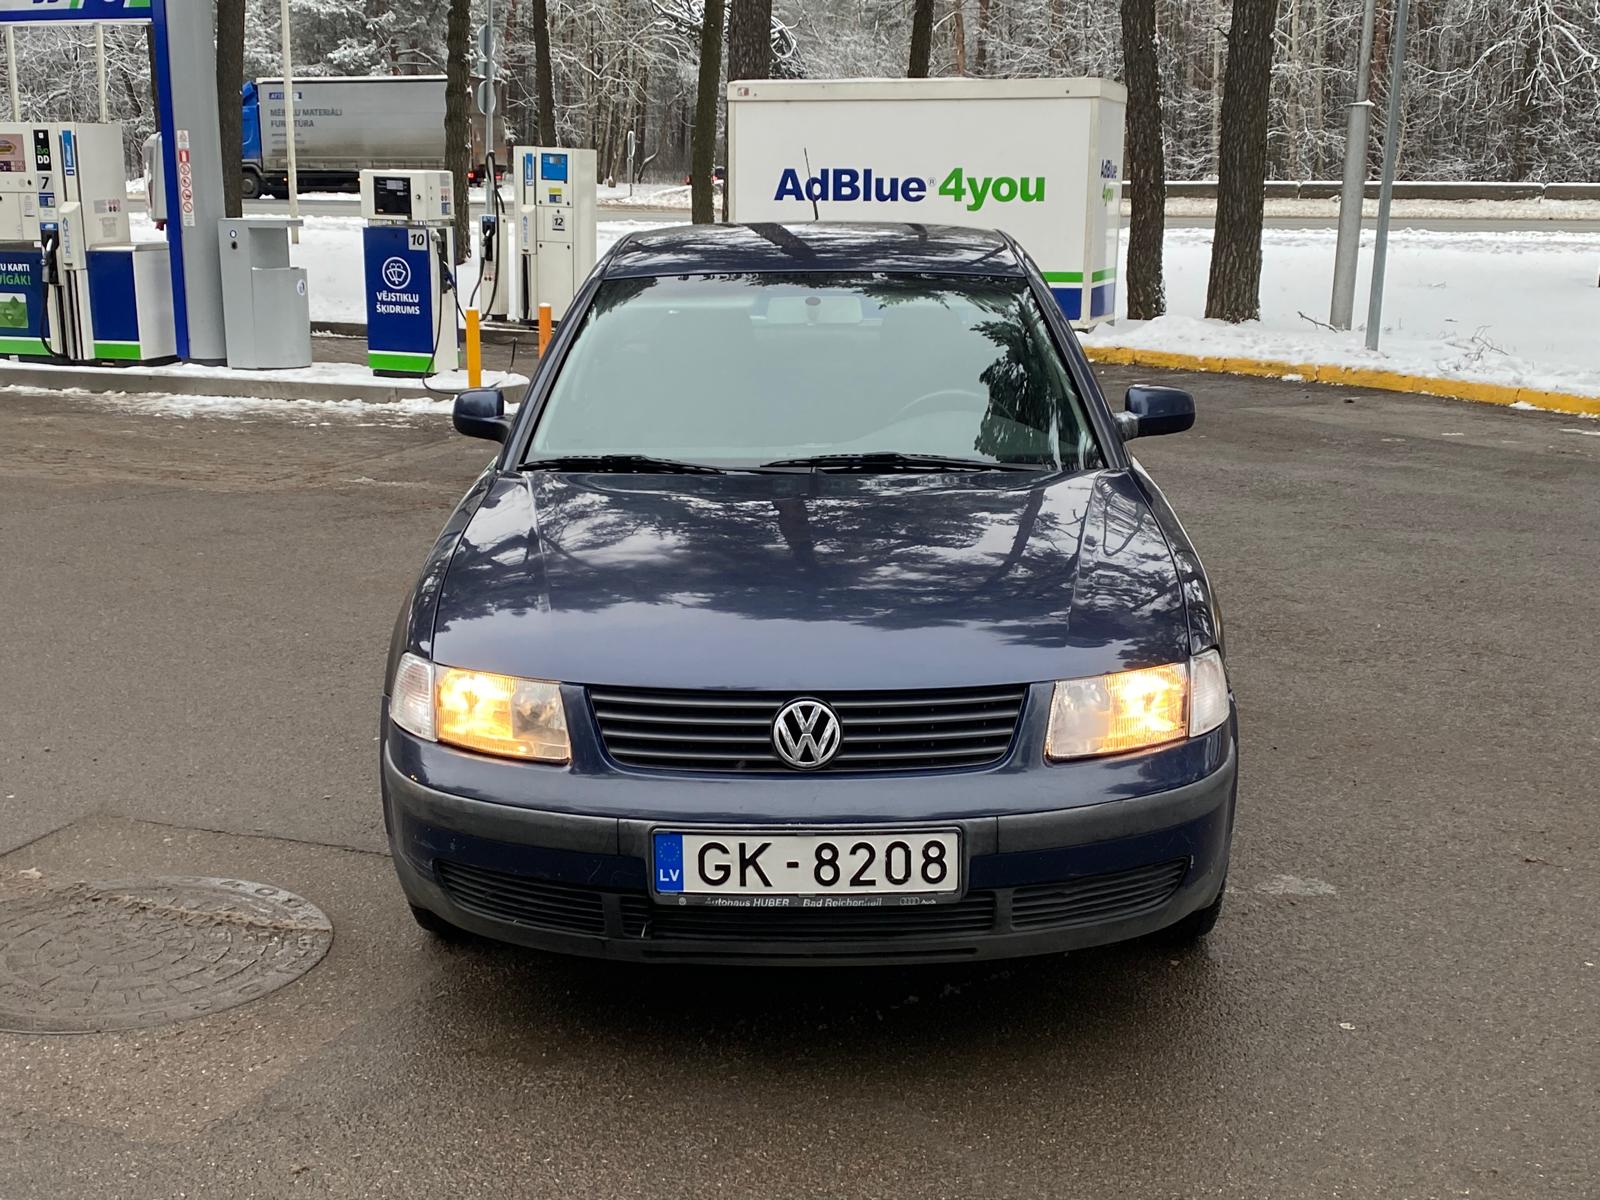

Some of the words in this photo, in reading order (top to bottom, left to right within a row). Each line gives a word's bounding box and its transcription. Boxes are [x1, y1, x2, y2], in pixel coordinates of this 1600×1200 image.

[37, 155, 49, 163] DD
[41, 176, 49, 189] 7
[938, 168, 1046, 212] 4you
[554, 217, 564, 226] 12
[410, 233, 425, 246] 10
[7, 263, 30, 272] KARTI
[376, 290, 419, 303] VĒJSTIKLU
[376, 302, 420, 315] ŠĶIDRUMS
[659, 869, 680, 882] LV
[753, 898, 790, 907] HUBER
[802, 898, 823, 908] Bad
